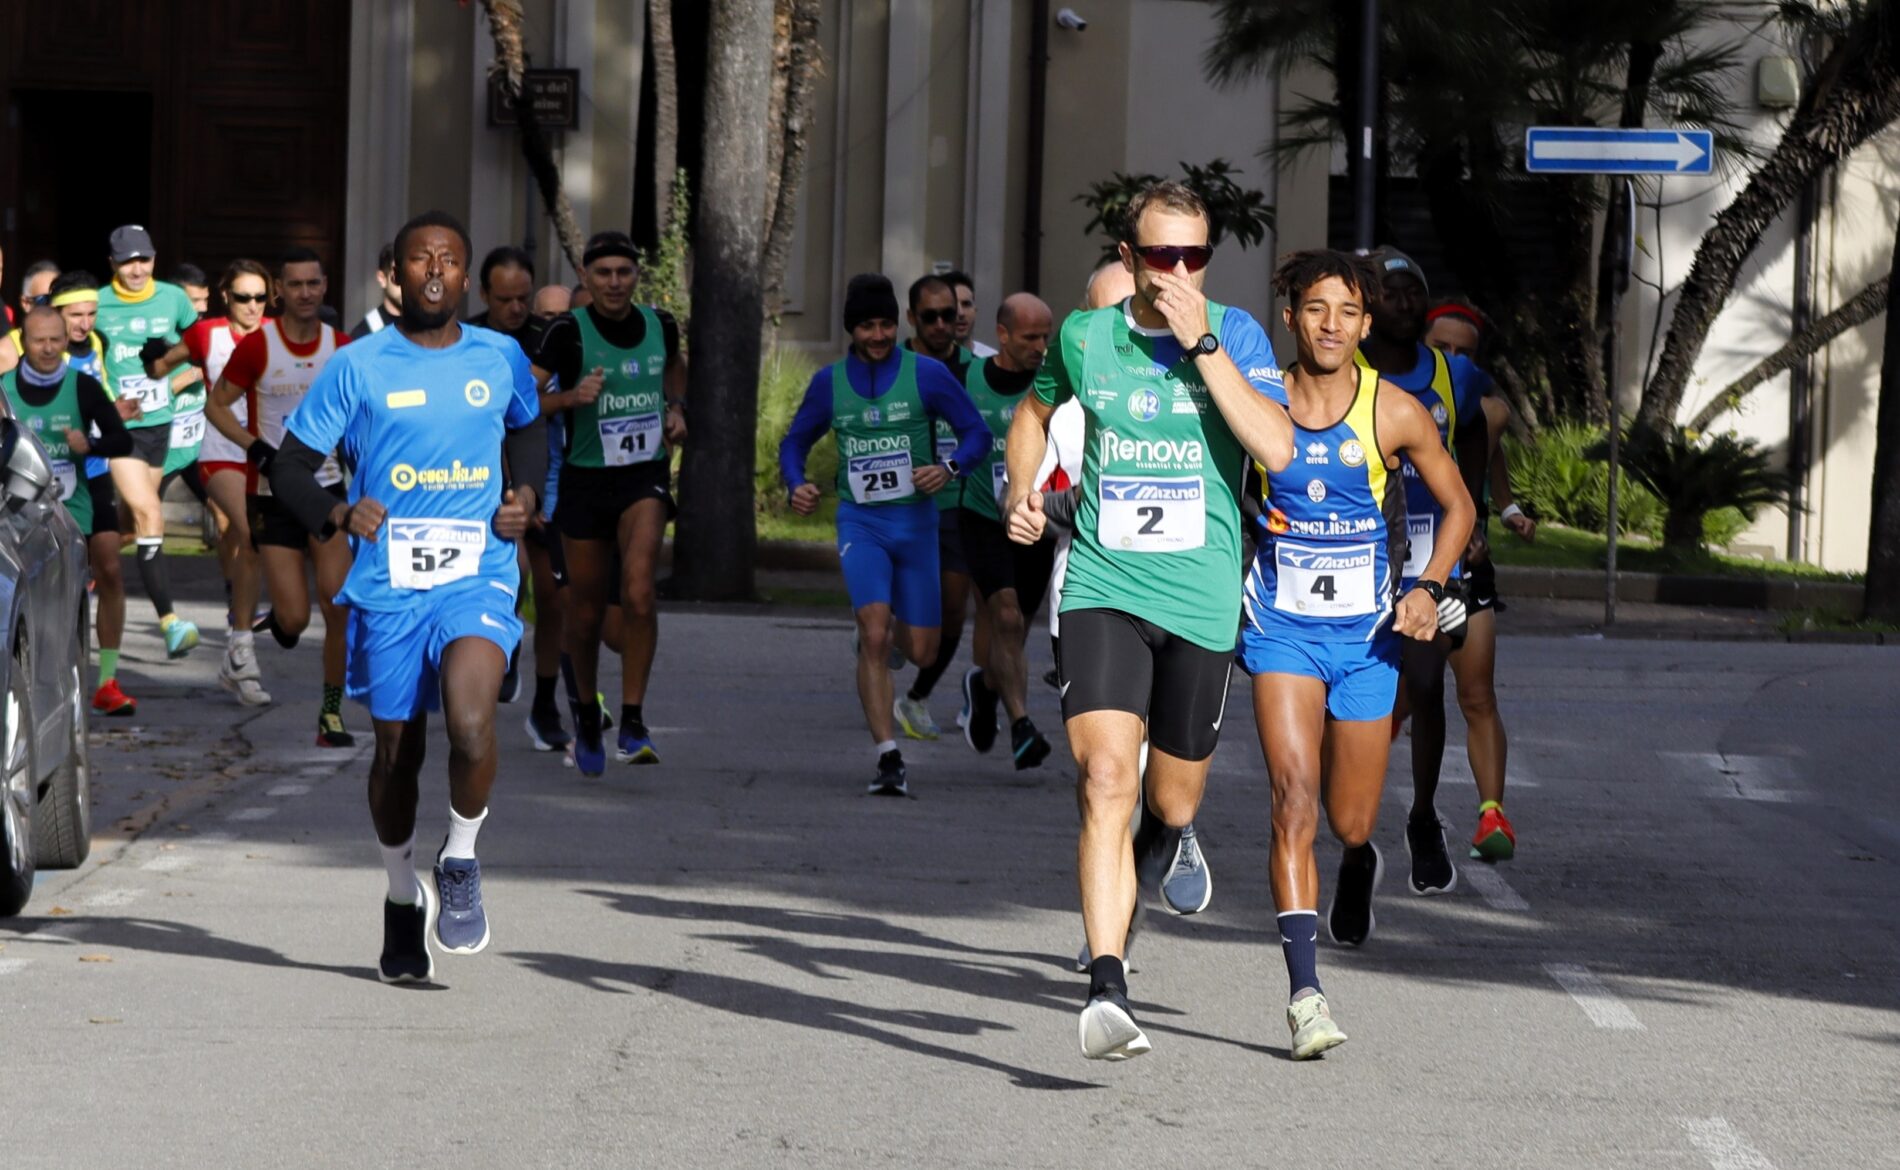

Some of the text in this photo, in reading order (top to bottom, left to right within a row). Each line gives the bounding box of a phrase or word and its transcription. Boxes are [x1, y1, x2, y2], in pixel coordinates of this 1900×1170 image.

[137, 387, 158, 402] 21
[599, 391, 659, 416] Renova
[1130, 397, 1158, 413] K42
[620, 432, 646, 453] 41
[846, 434, 911, 457] Renova
[1100, 431, 1203, 469] Renova
[869, 457, 908, 470] Mizuno
[862, 470, 899, 491] 29
[1135, 485, 1199, 500] Mizuno
[1137, 506, 1164, 535] 2
[412, 547, 461, 572] 52
[1310, 555, 1370, 569] Mizuno
[1310, 575, 1338, 601] 4
